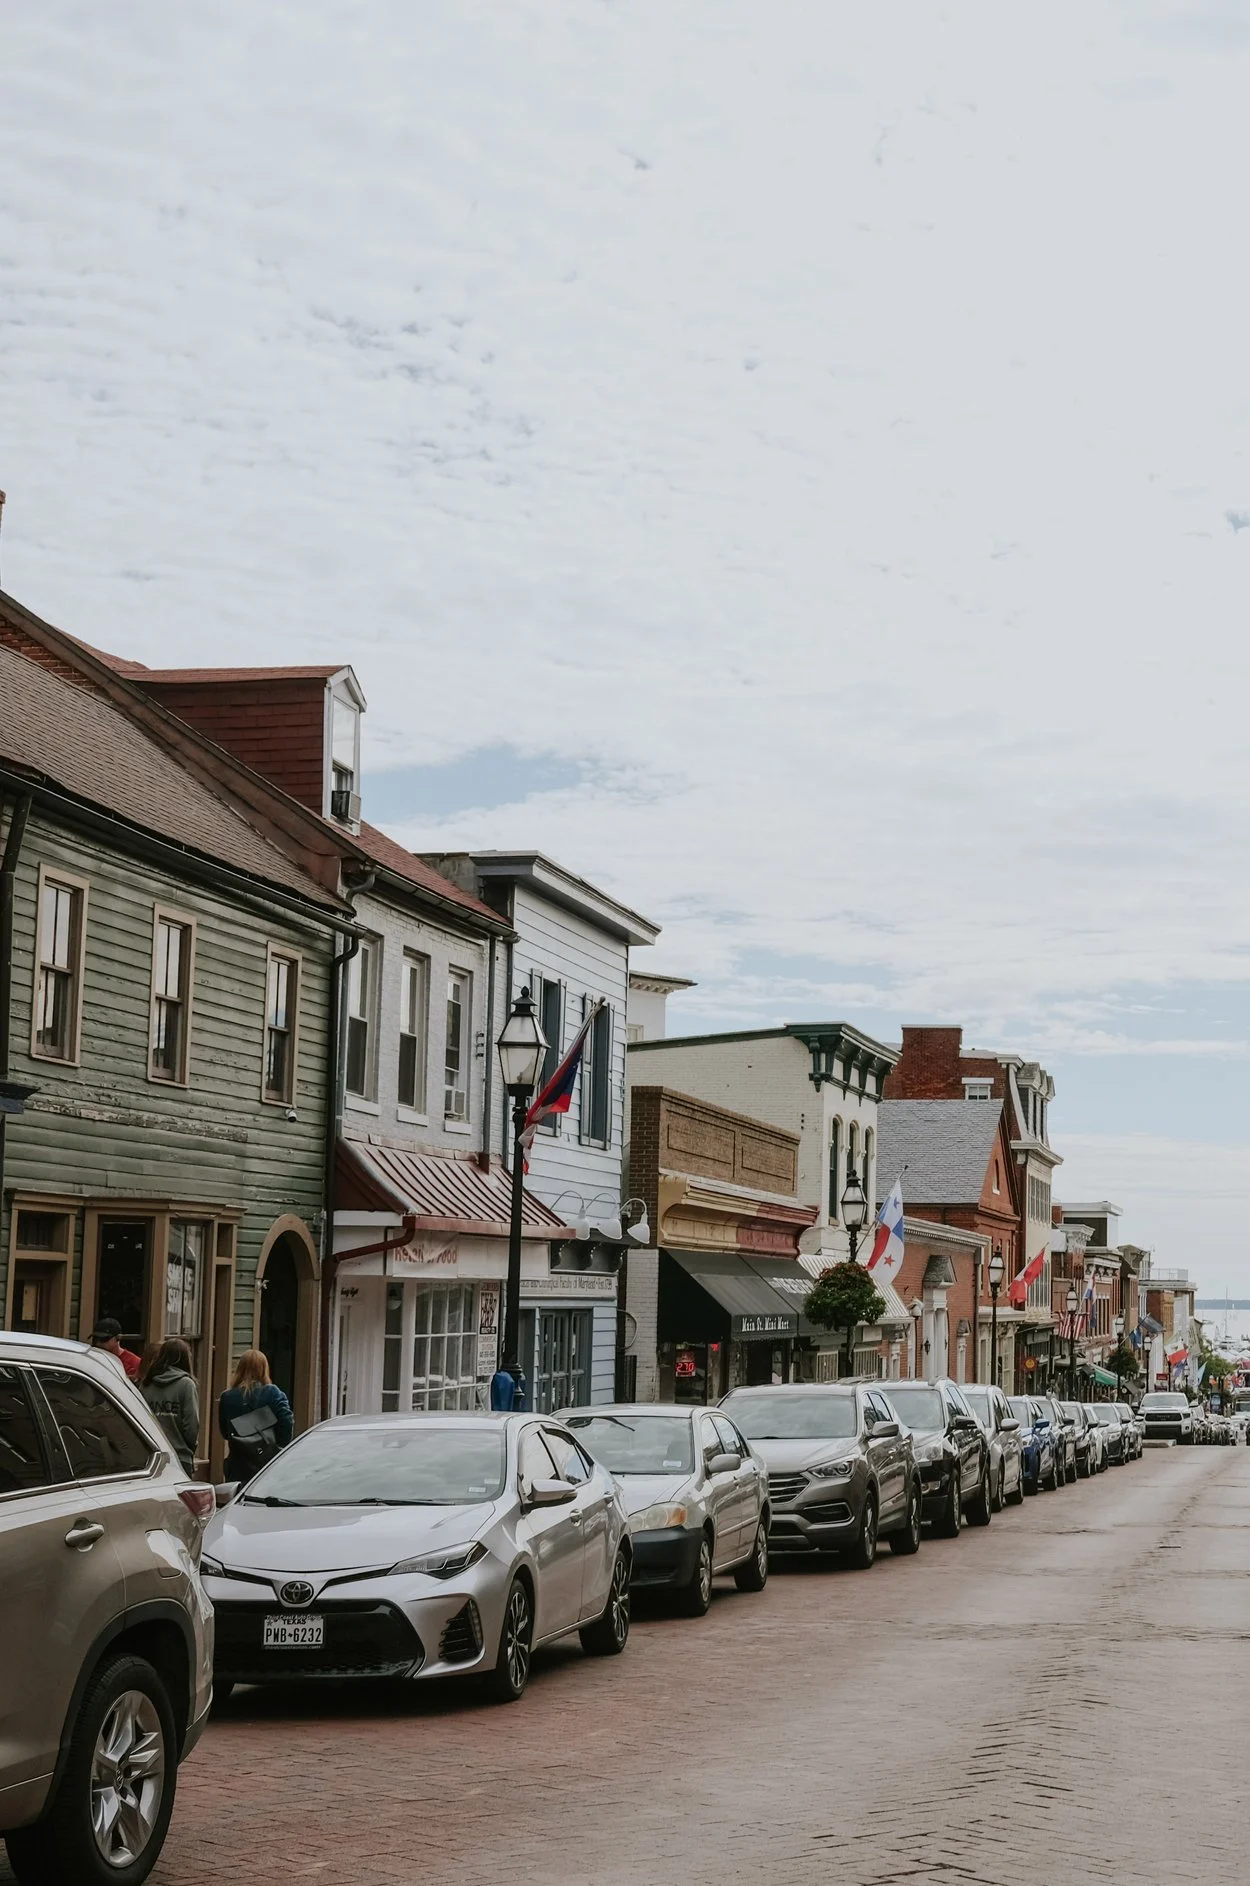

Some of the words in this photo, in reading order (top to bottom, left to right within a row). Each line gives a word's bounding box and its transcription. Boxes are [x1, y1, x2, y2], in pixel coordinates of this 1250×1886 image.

[741, 1317, 755, 1332] Main
[764, 1316, 776, 1331] Mini
[777, 1316, 789, 1330] Mart
[293, 1627, 322, 1643] 6232
